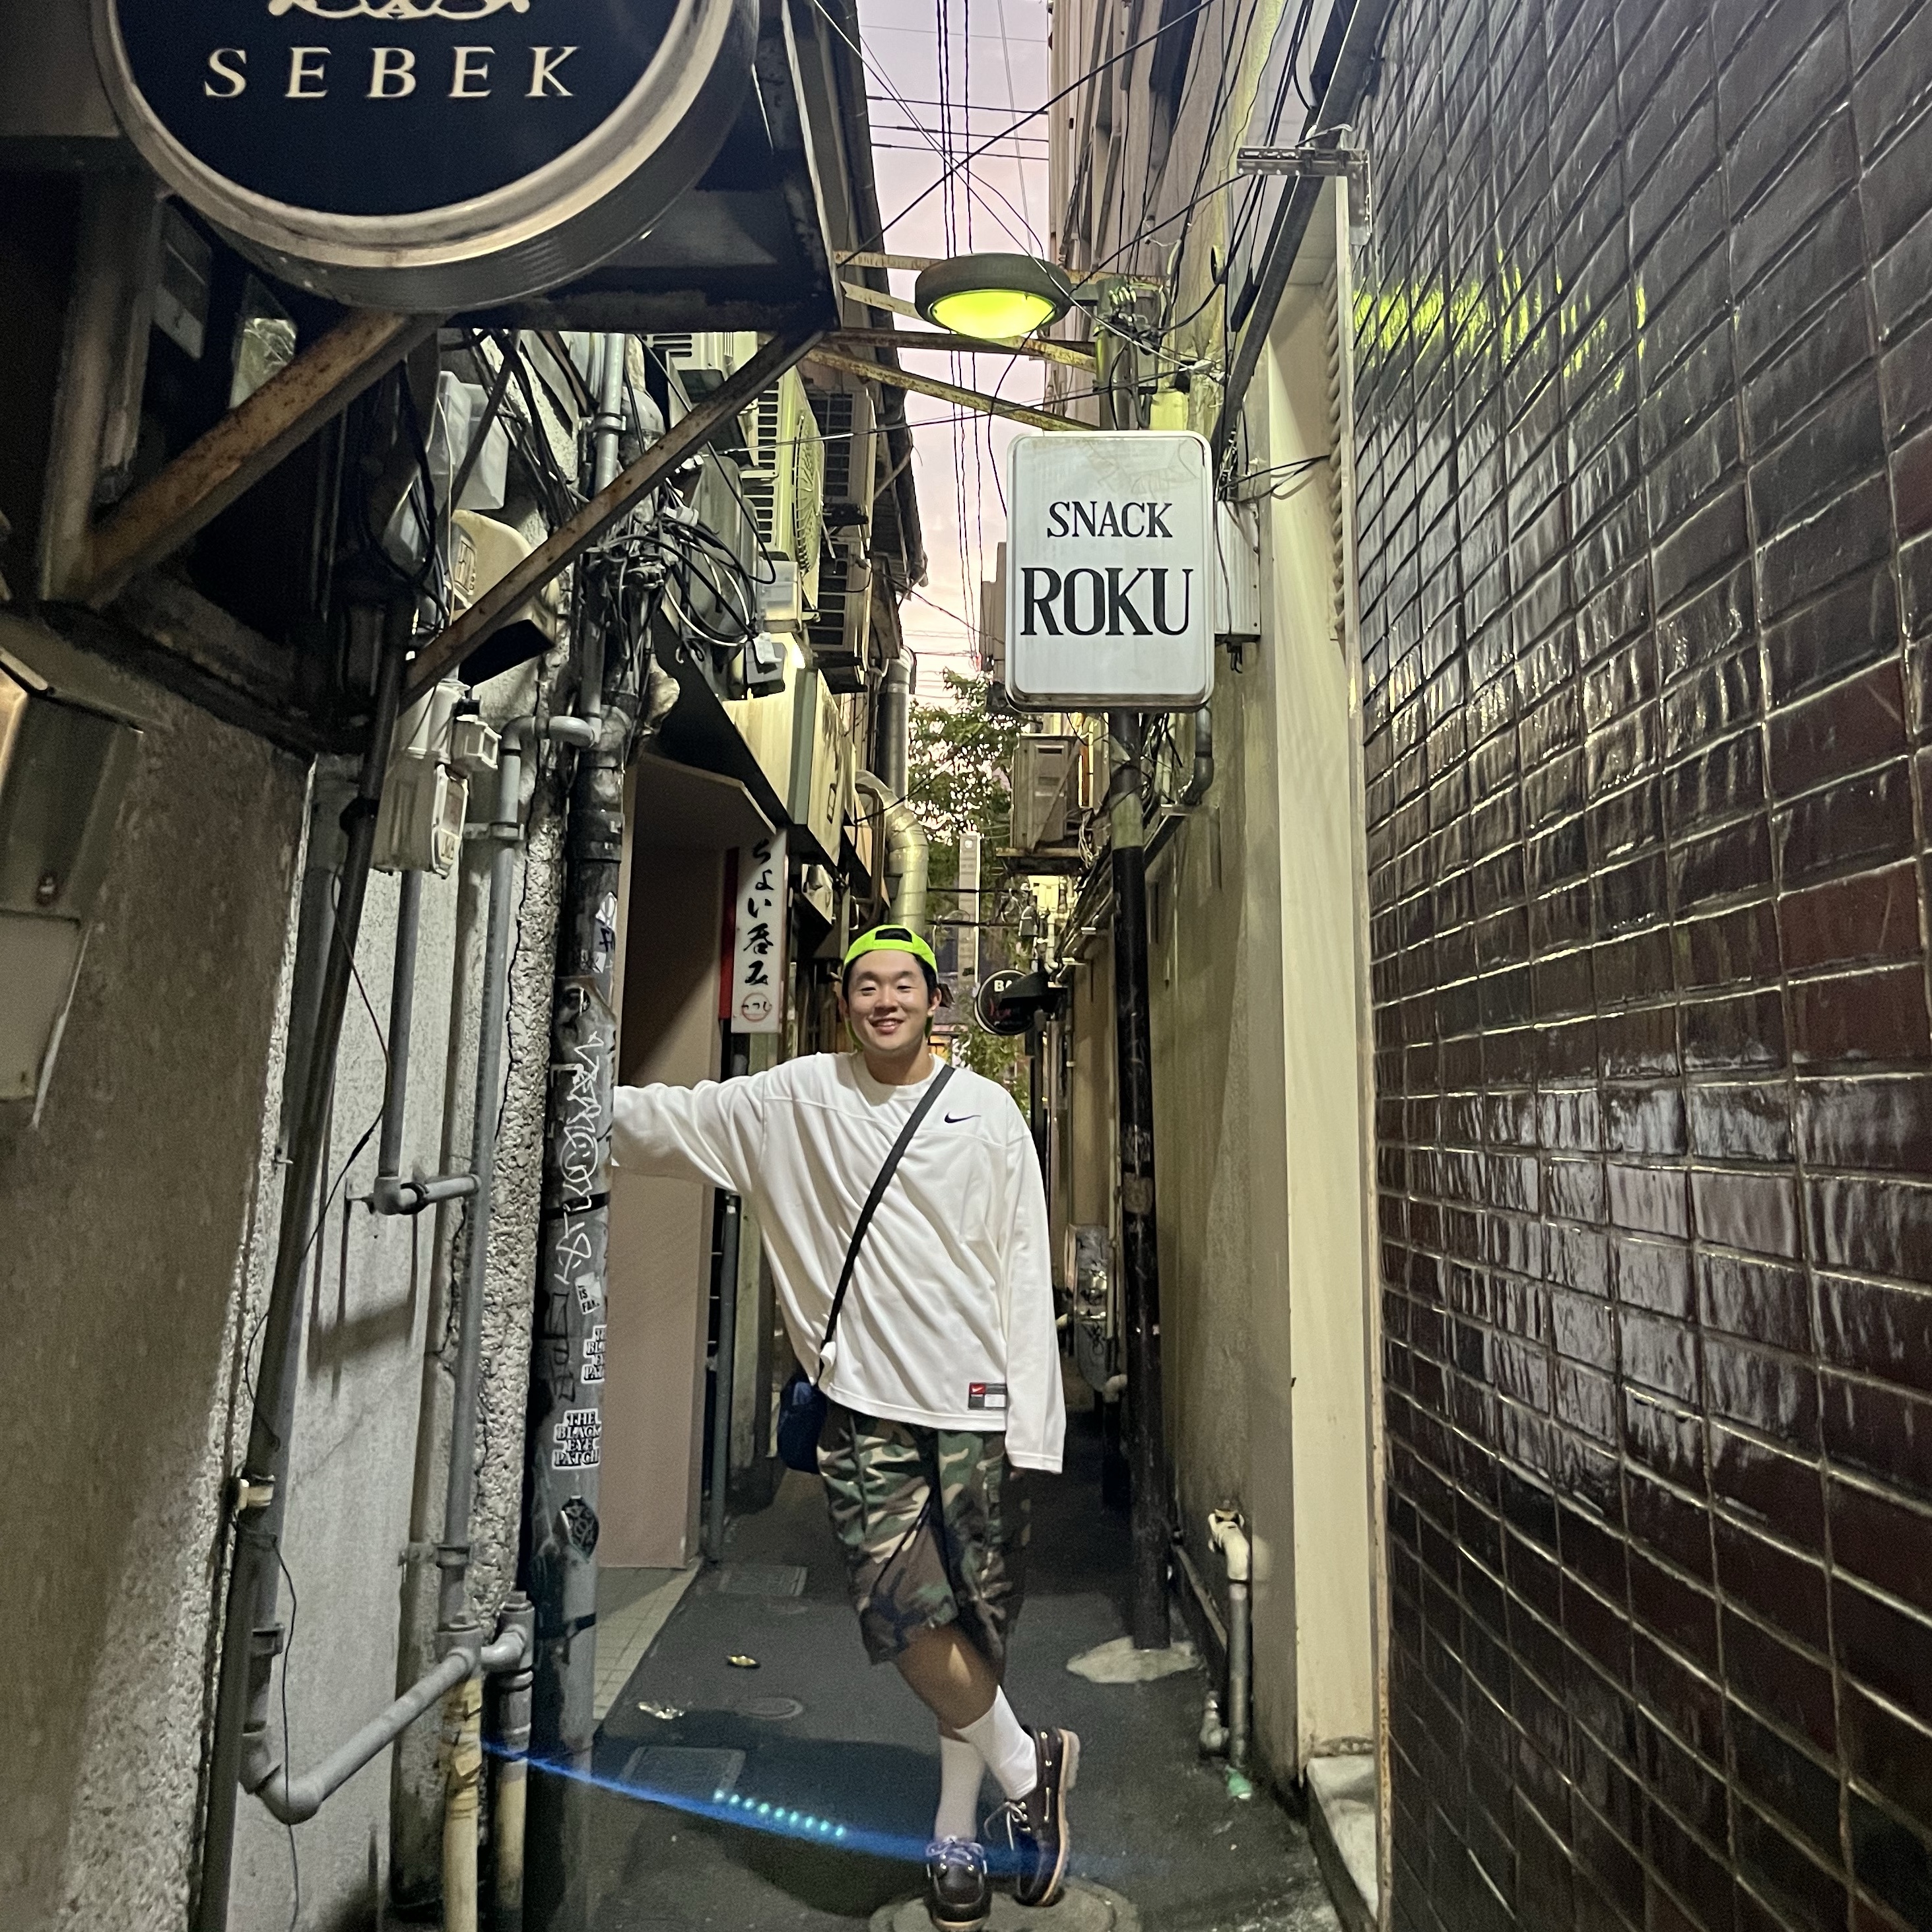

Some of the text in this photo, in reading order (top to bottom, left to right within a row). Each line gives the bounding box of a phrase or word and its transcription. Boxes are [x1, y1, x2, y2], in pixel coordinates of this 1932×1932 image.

[203, 46, 580, 98] SEBEK
[1047, 501, 1173, 538] SNACK
[1020, 567, 1194, 636] ROKU
[567, 1413, 595, 1426] THE
[556, 1425, 601, 1440] BLACK
[567, 1438, 593, 1451] EYE
[555, 1449, 599, 1466] PATCH
